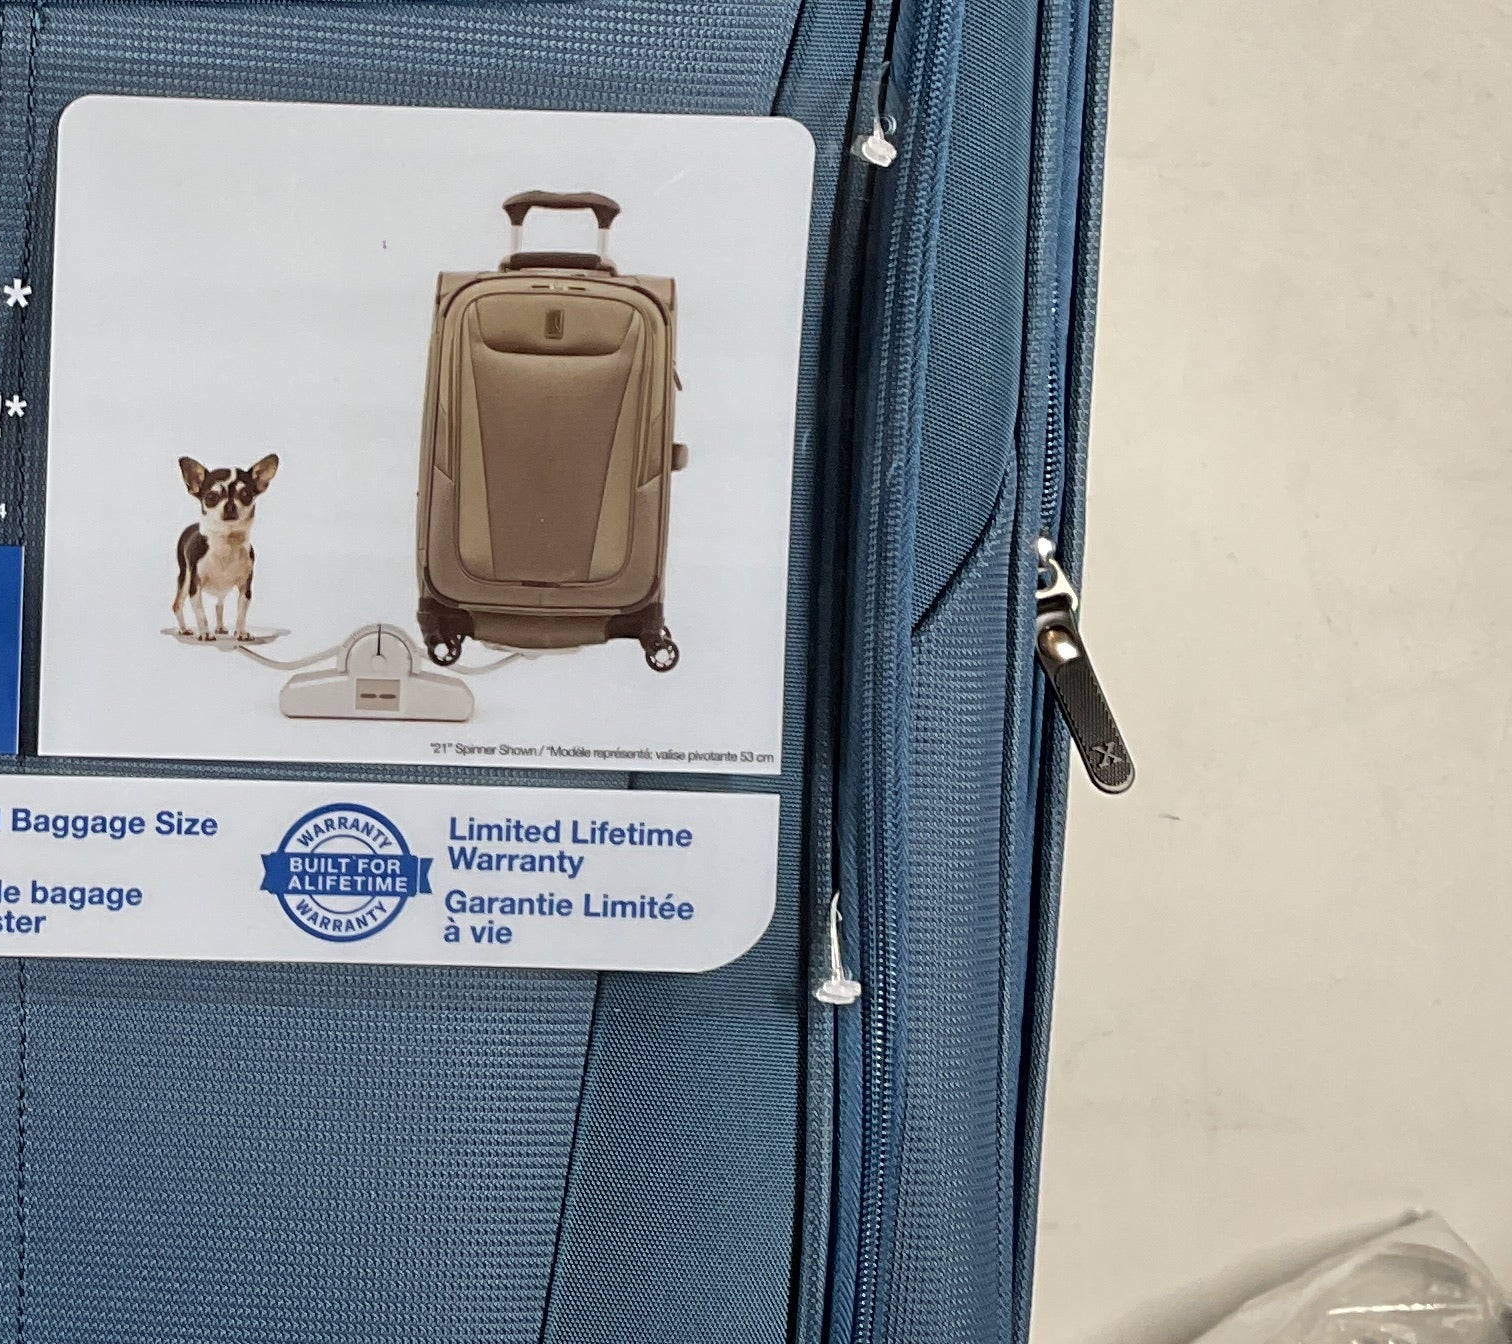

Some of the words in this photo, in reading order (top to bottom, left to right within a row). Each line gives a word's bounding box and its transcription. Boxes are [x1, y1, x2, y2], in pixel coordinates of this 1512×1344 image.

[499, 744, 537, 757] Shown
[740, 752, 754, 763] 53
[756, 754, 774, 763] cm
[12, 807, 145, 840] Baggage
[155, 810, 218, 836] Size
[297, 816, 392, 849] WARRANTY
[449, 816, 561, 844] Limited
[571, 819, 693, 847] Lifetime
[289, 857, 351, 873] BUILT
[358, 859, 401, 874] FOR
[448, 846, 584, 879] Warranty
[31, 881, 143, 911] bagage
[445, 889, 573, 917] Garantie
[583, 893, 694, 920] Limitée
[295, 898, 388, 933] WARRANTY
[443, 916, 460, 943] à
[470, 919, 513, 944] vie
